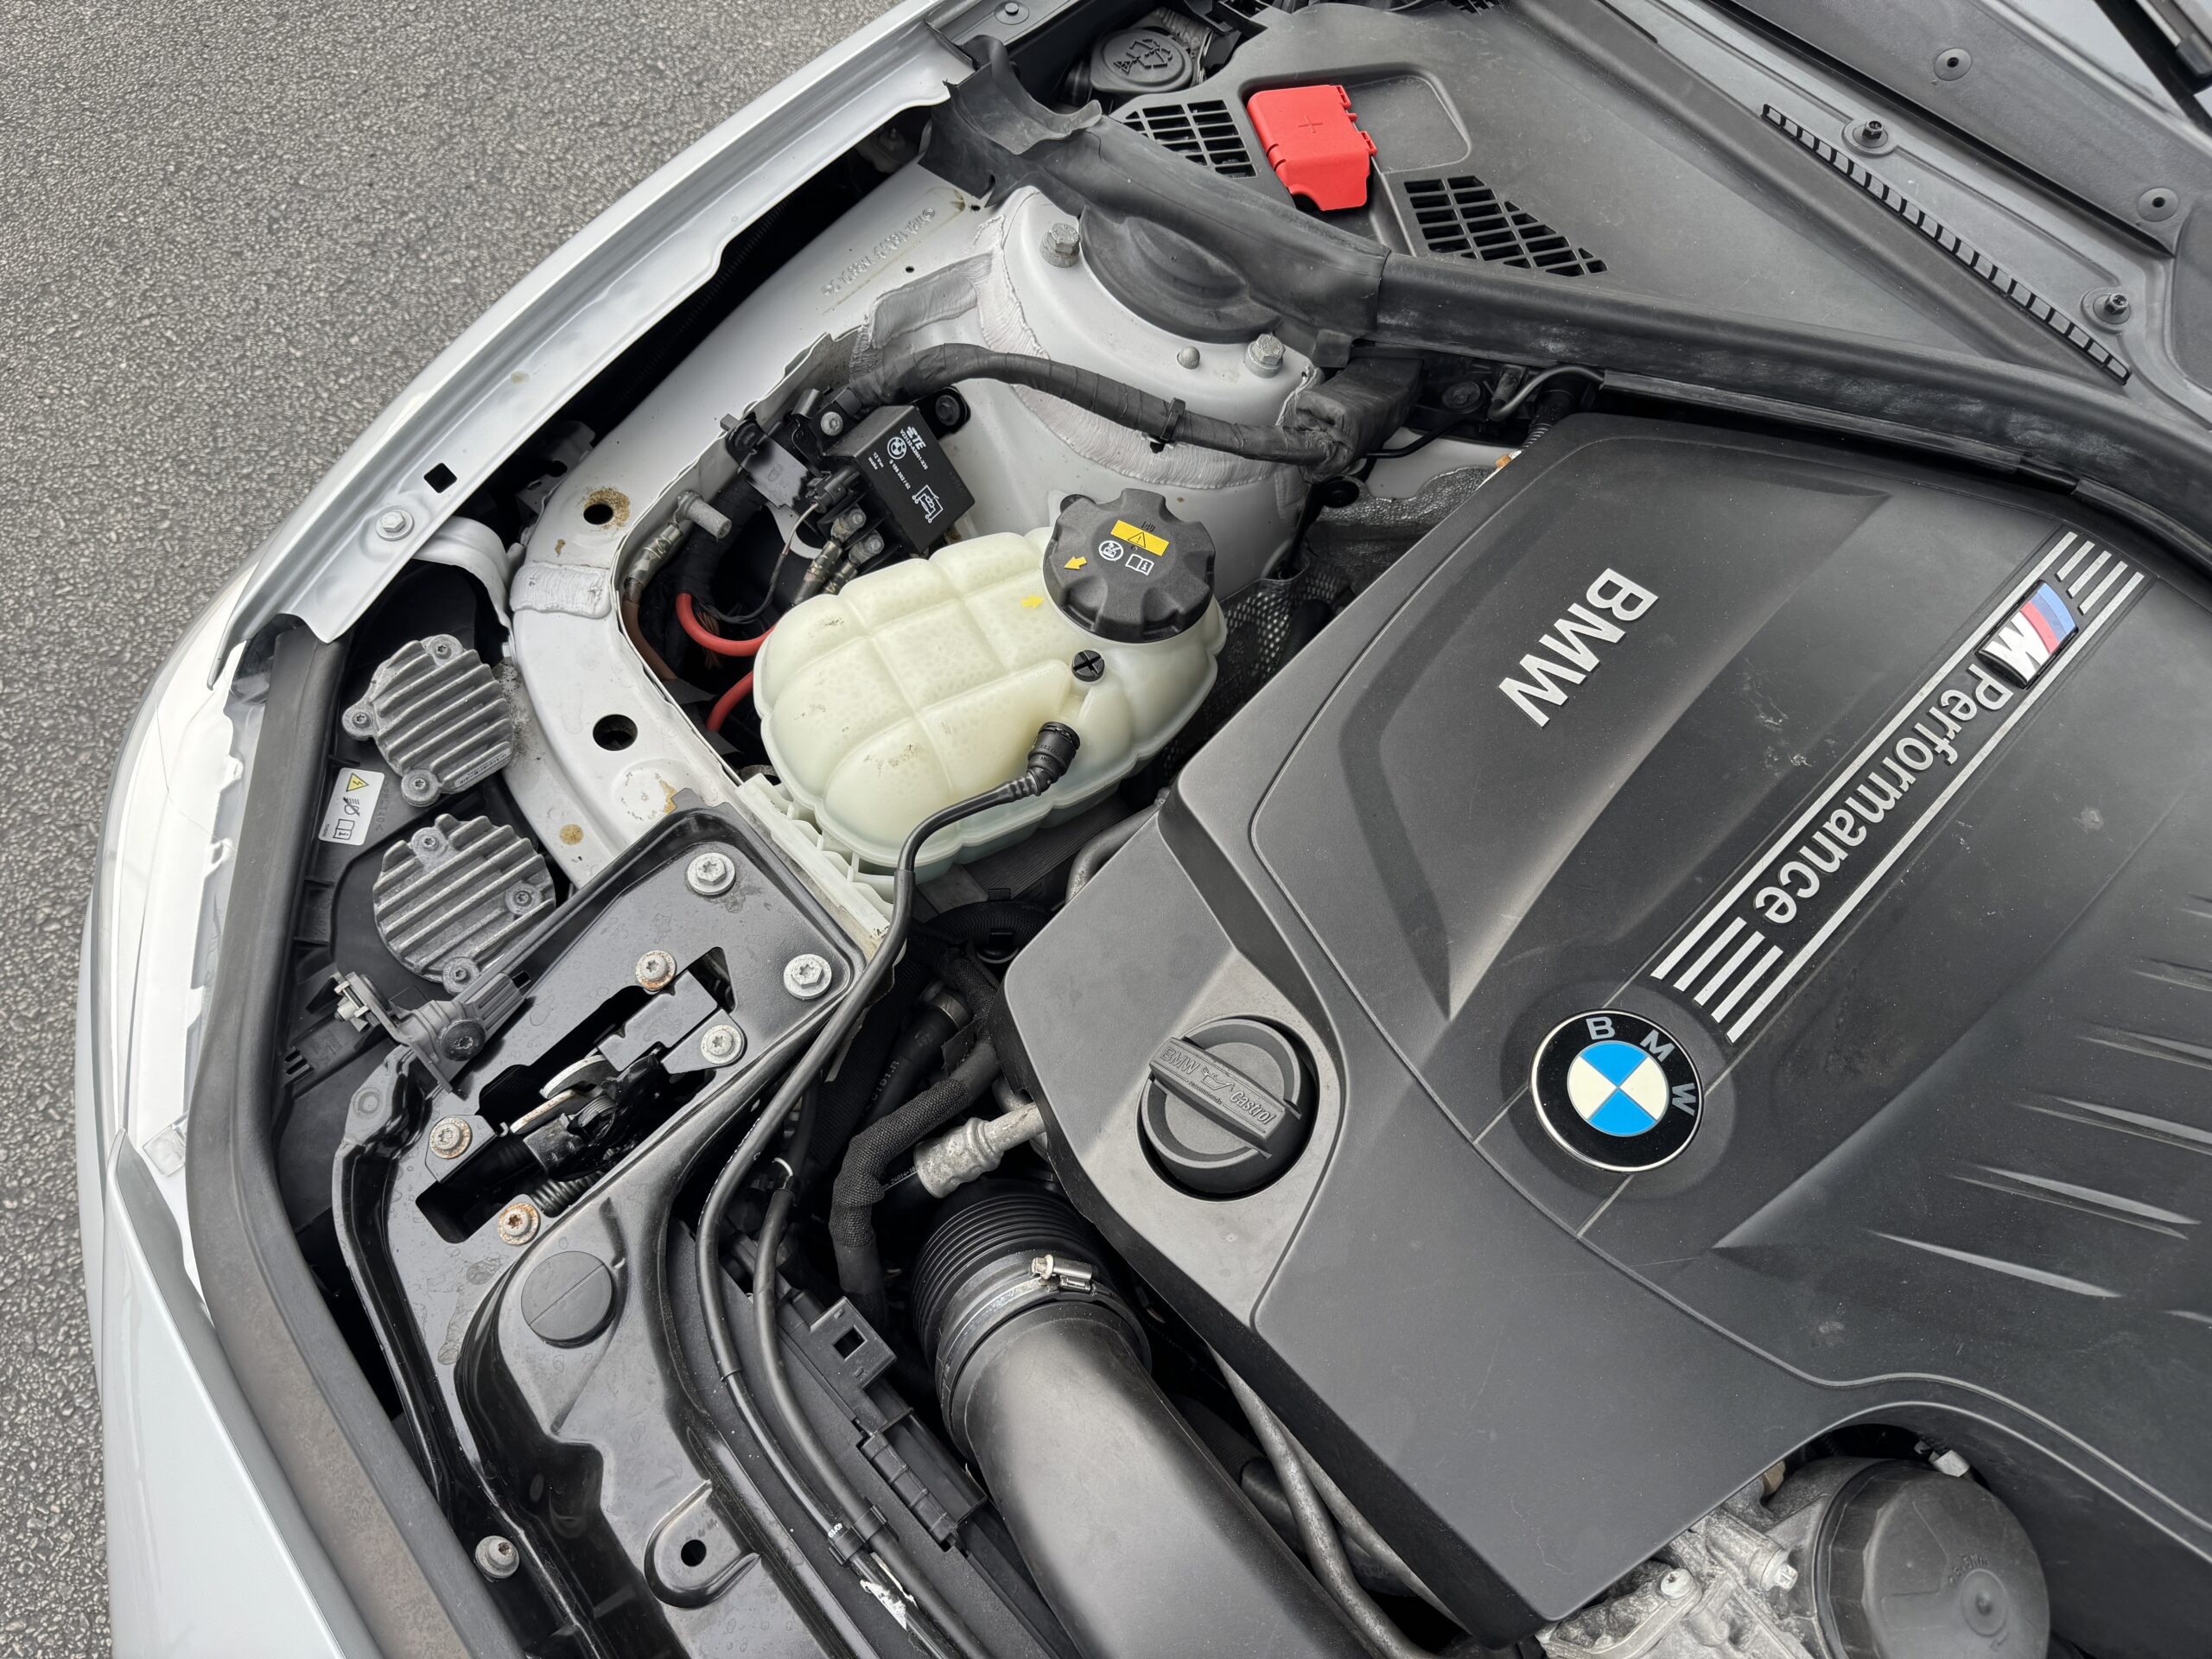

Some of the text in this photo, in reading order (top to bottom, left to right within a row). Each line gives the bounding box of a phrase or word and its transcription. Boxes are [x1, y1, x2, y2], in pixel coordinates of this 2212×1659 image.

[1498, 568, 1659, 728] BMW
[1753, 610, 2051, 924] M Performance
[1160, 1046, 1277, 1124] BMW Castrol
[1187, 1080, 1224, 1106] recommends
[1586, 1016, 1696, 1116] BMW
